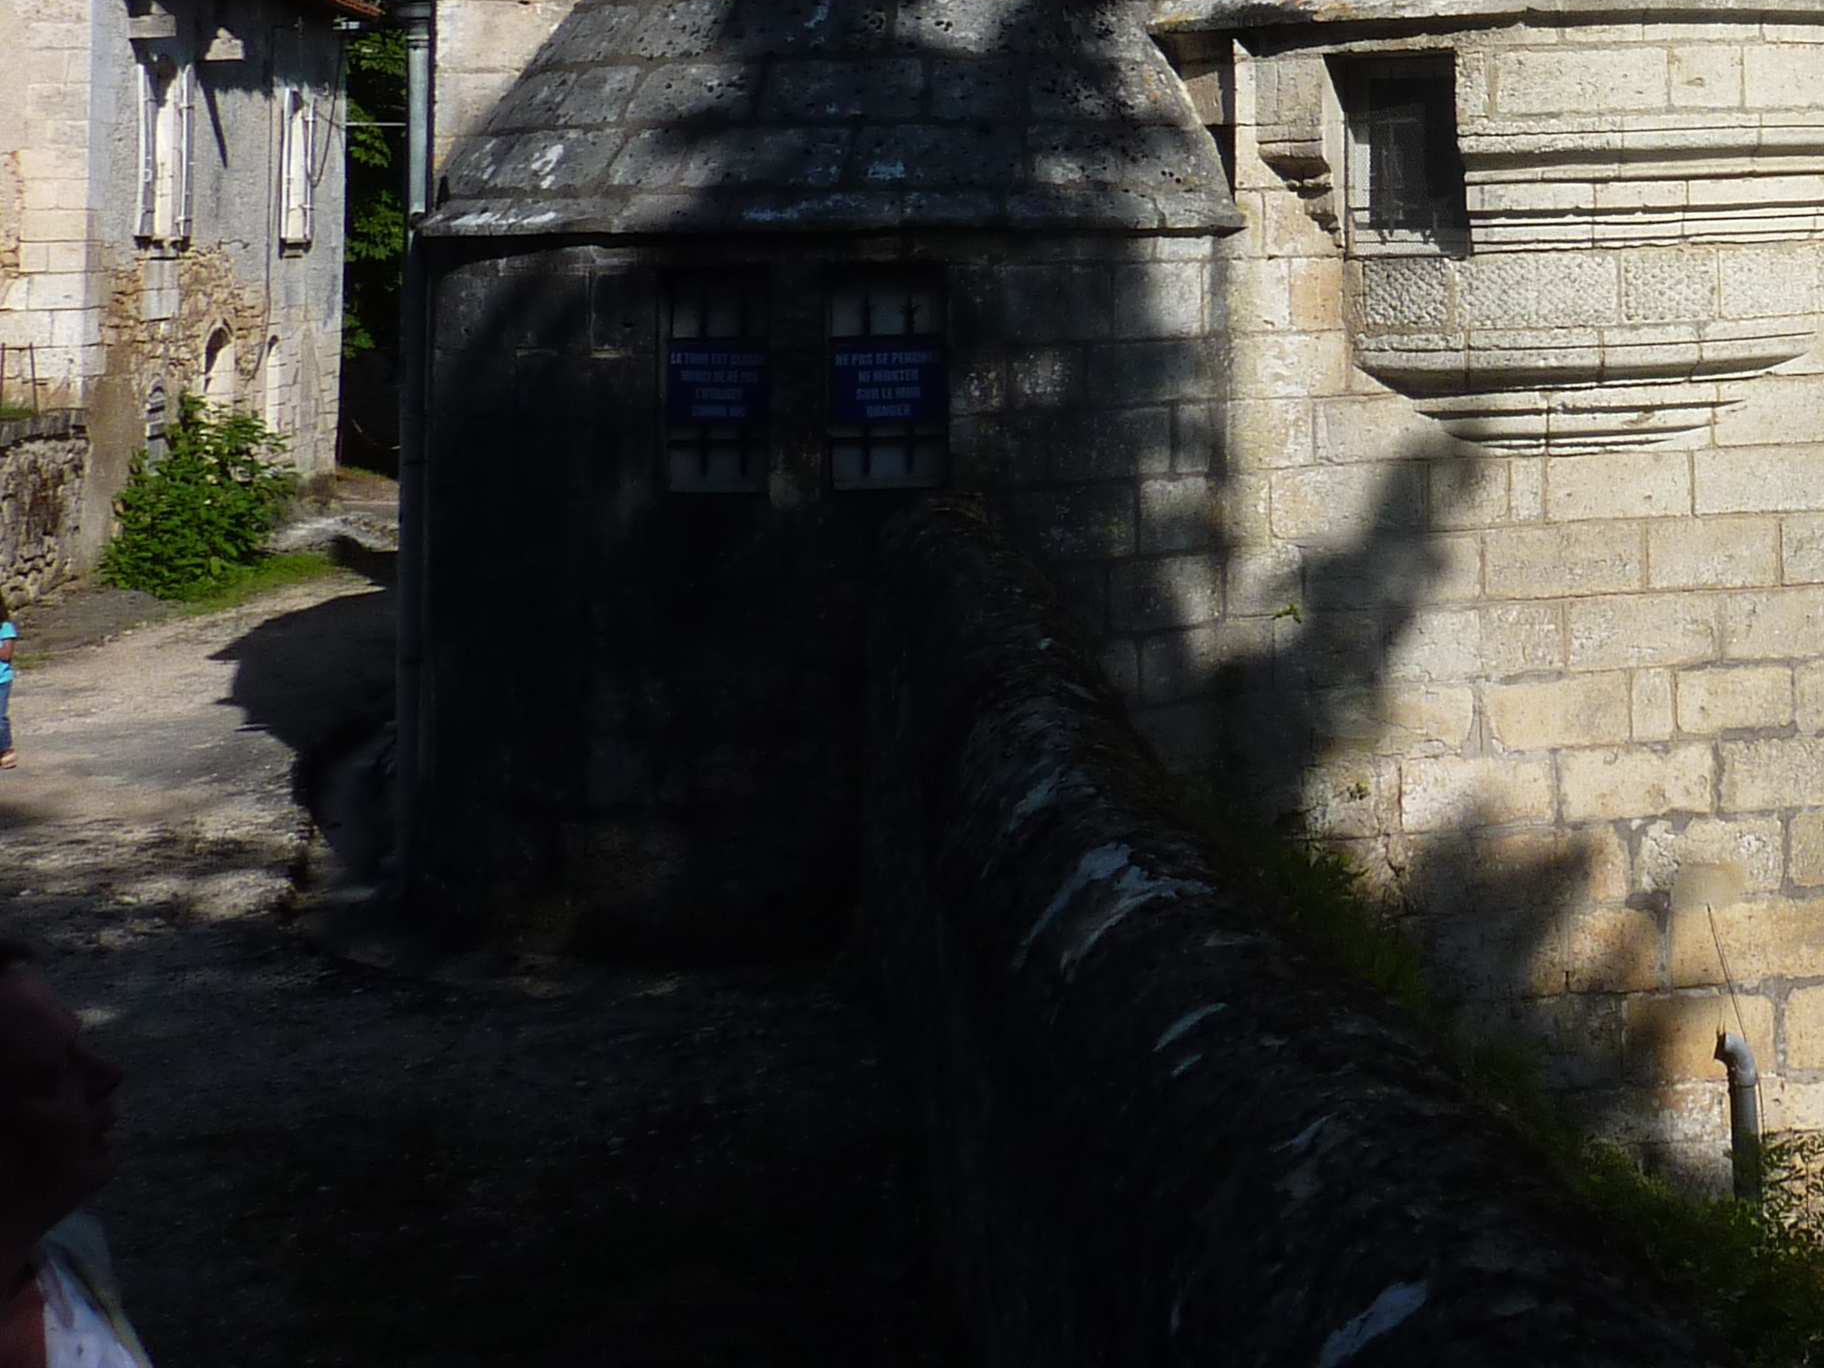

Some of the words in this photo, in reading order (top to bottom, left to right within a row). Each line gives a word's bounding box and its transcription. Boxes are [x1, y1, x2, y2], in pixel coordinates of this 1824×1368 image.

[671, 352, 683, 365] LA
[835, 353, 849, 366] NE
[852, 353, 873, 365] PAS
[875, 352, 888, 364] SE
[858, 370, 870, 383] NI
[872, 369, 918, 382] MONTER
[856, 388, 879, 400] SUR
[881, 387, 893, 399] LE
